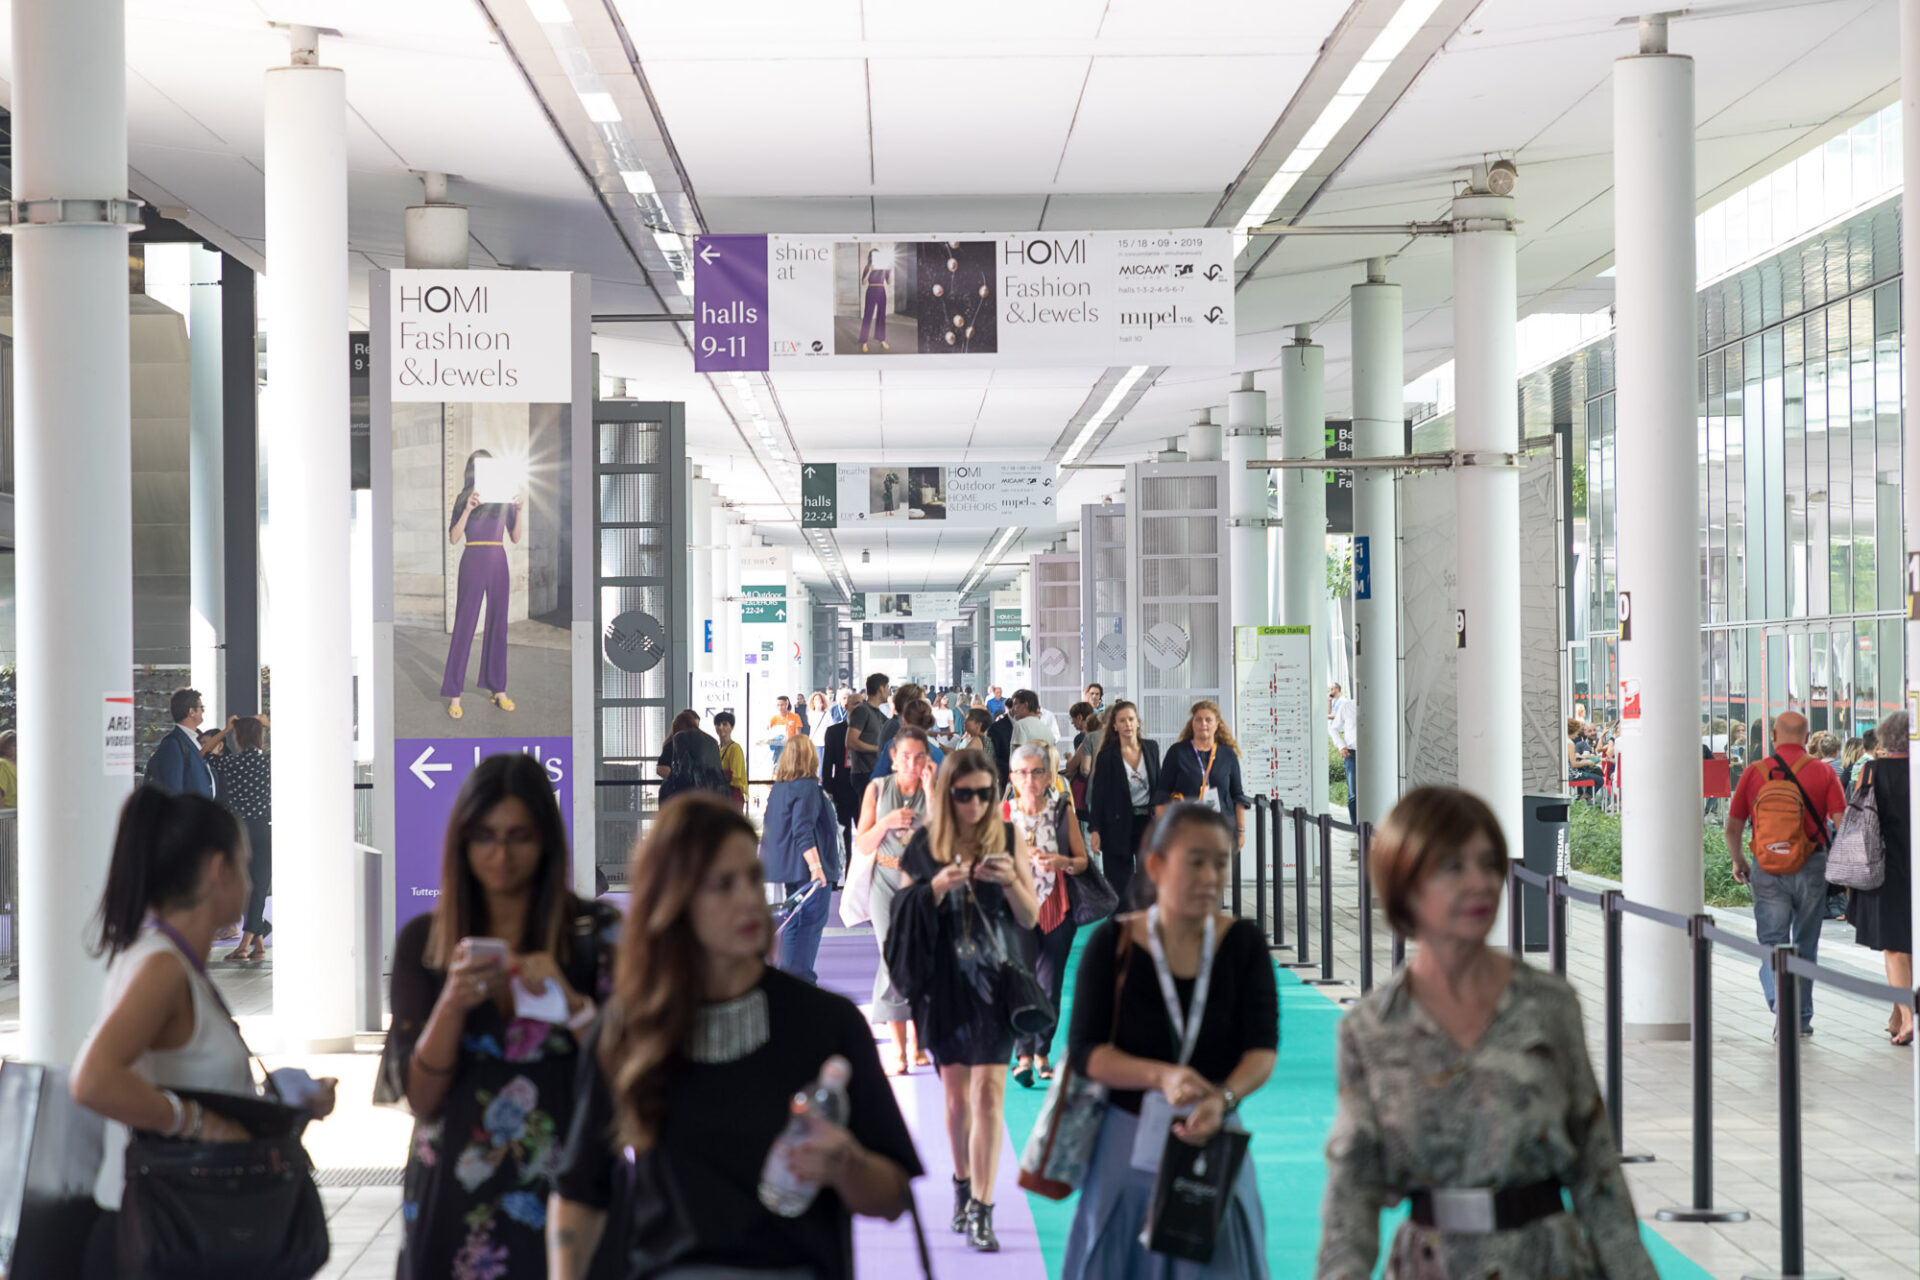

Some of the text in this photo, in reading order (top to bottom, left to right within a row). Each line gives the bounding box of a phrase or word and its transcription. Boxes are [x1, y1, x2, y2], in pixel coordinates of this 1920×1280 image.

[1118, 239, 1129, 248] 15
[1137, 239, 1148, 248] 18
[1157, 239, 1170, 247] 09
[1180, 238, 1203, 247] 2019
[776, 243, 829, 261] shine
[1004, 239, 1086, 265] HOMI
[776, 264, 796, 280] at
[1118, 264, 1167, 275] MICAM
[1005, 275, 1091, 298] Fashion
[1118, 286, 1135, 294] halls
[400, 285, 488, 314] HOMI
[702, 301, 758, 324] halls
[1006, 301, 1099, 324] &Jewels
[1120, 305, 1176, 330] mipel
[400, 321, 511, 350] Fashion
[701, 336, 746, 358] 9-11
[399, 357, 518, 387] &Jewels
[948, 466, 981, 478] HOMI
[948, 480, 996, 491] Outdoor
[1338, 478, 1352, 488] Fa
[804, 495, 831, 507] halls
[804, 511, 833, 521] 22-24
[700, 676, 739, 688] uscita
[707, 690, 730, 702] exit
[410, 886, 442, 898] Tuttep
